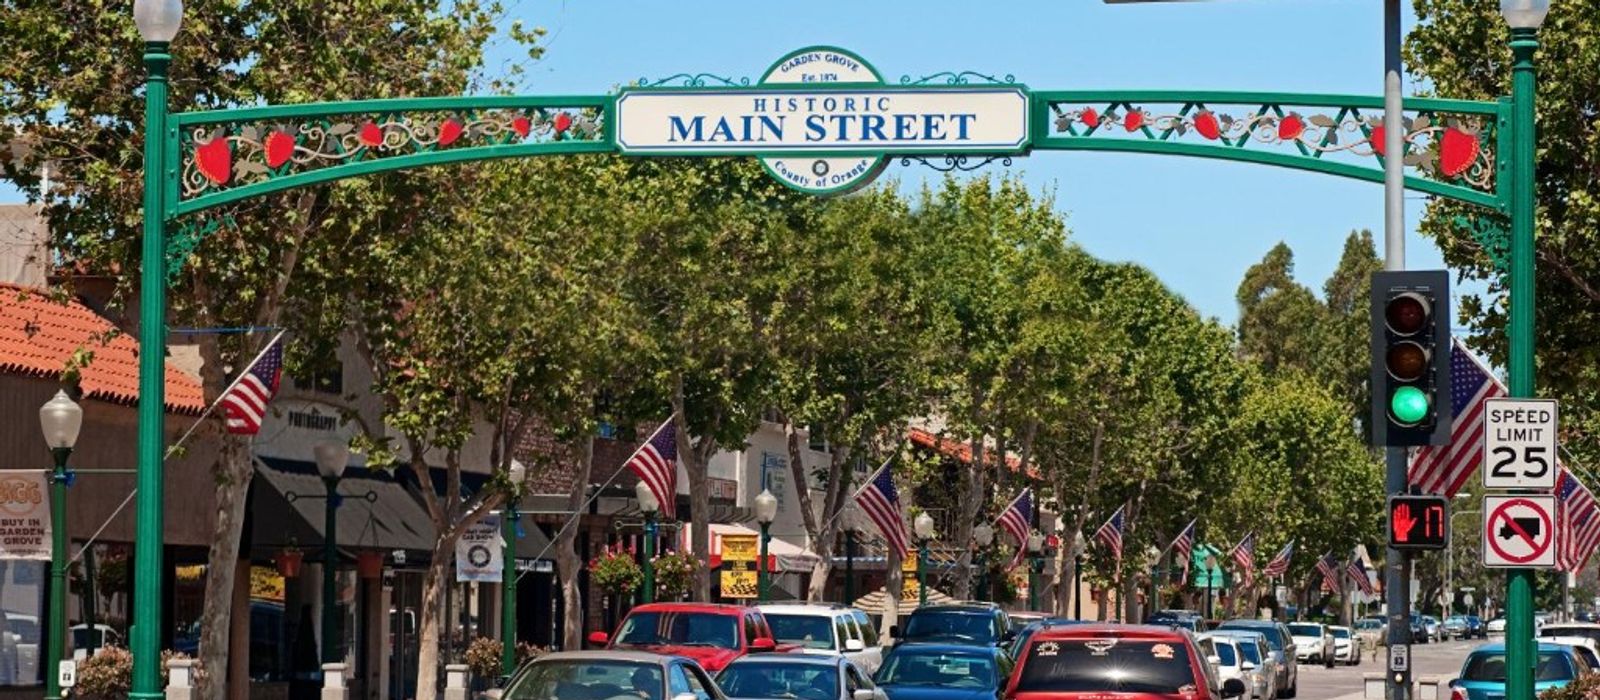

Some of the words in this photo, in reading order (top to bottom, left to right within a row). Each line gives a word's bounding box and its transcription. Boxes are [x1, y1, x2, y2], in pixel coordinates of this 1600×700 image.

[781, 53, 822, 73] GARDEN
[824, 53, 860, 72] GROVE
[753, 97, 890, 112] HISTORIC
[667, 115, 786, 142] MAIN
[805, 113, 977, 141] STREET
[774, 160, 810, 187] County
[815, 177, 827, 187] of
[831, 159, 868, 184] Orange
[1491, 409, 1550, 423] SPEED
[1496, 428, 1543, 442] LIMIT
[1490, 446, 1549, 478] 25
[1, 518, 25, 526] BUY
[28, 518, 40, 526] IN
[1425, 506, 1443, 538] 17
[0, 528, 45, 536] GARDEN
[4, 537, 42, 545] GROVE
